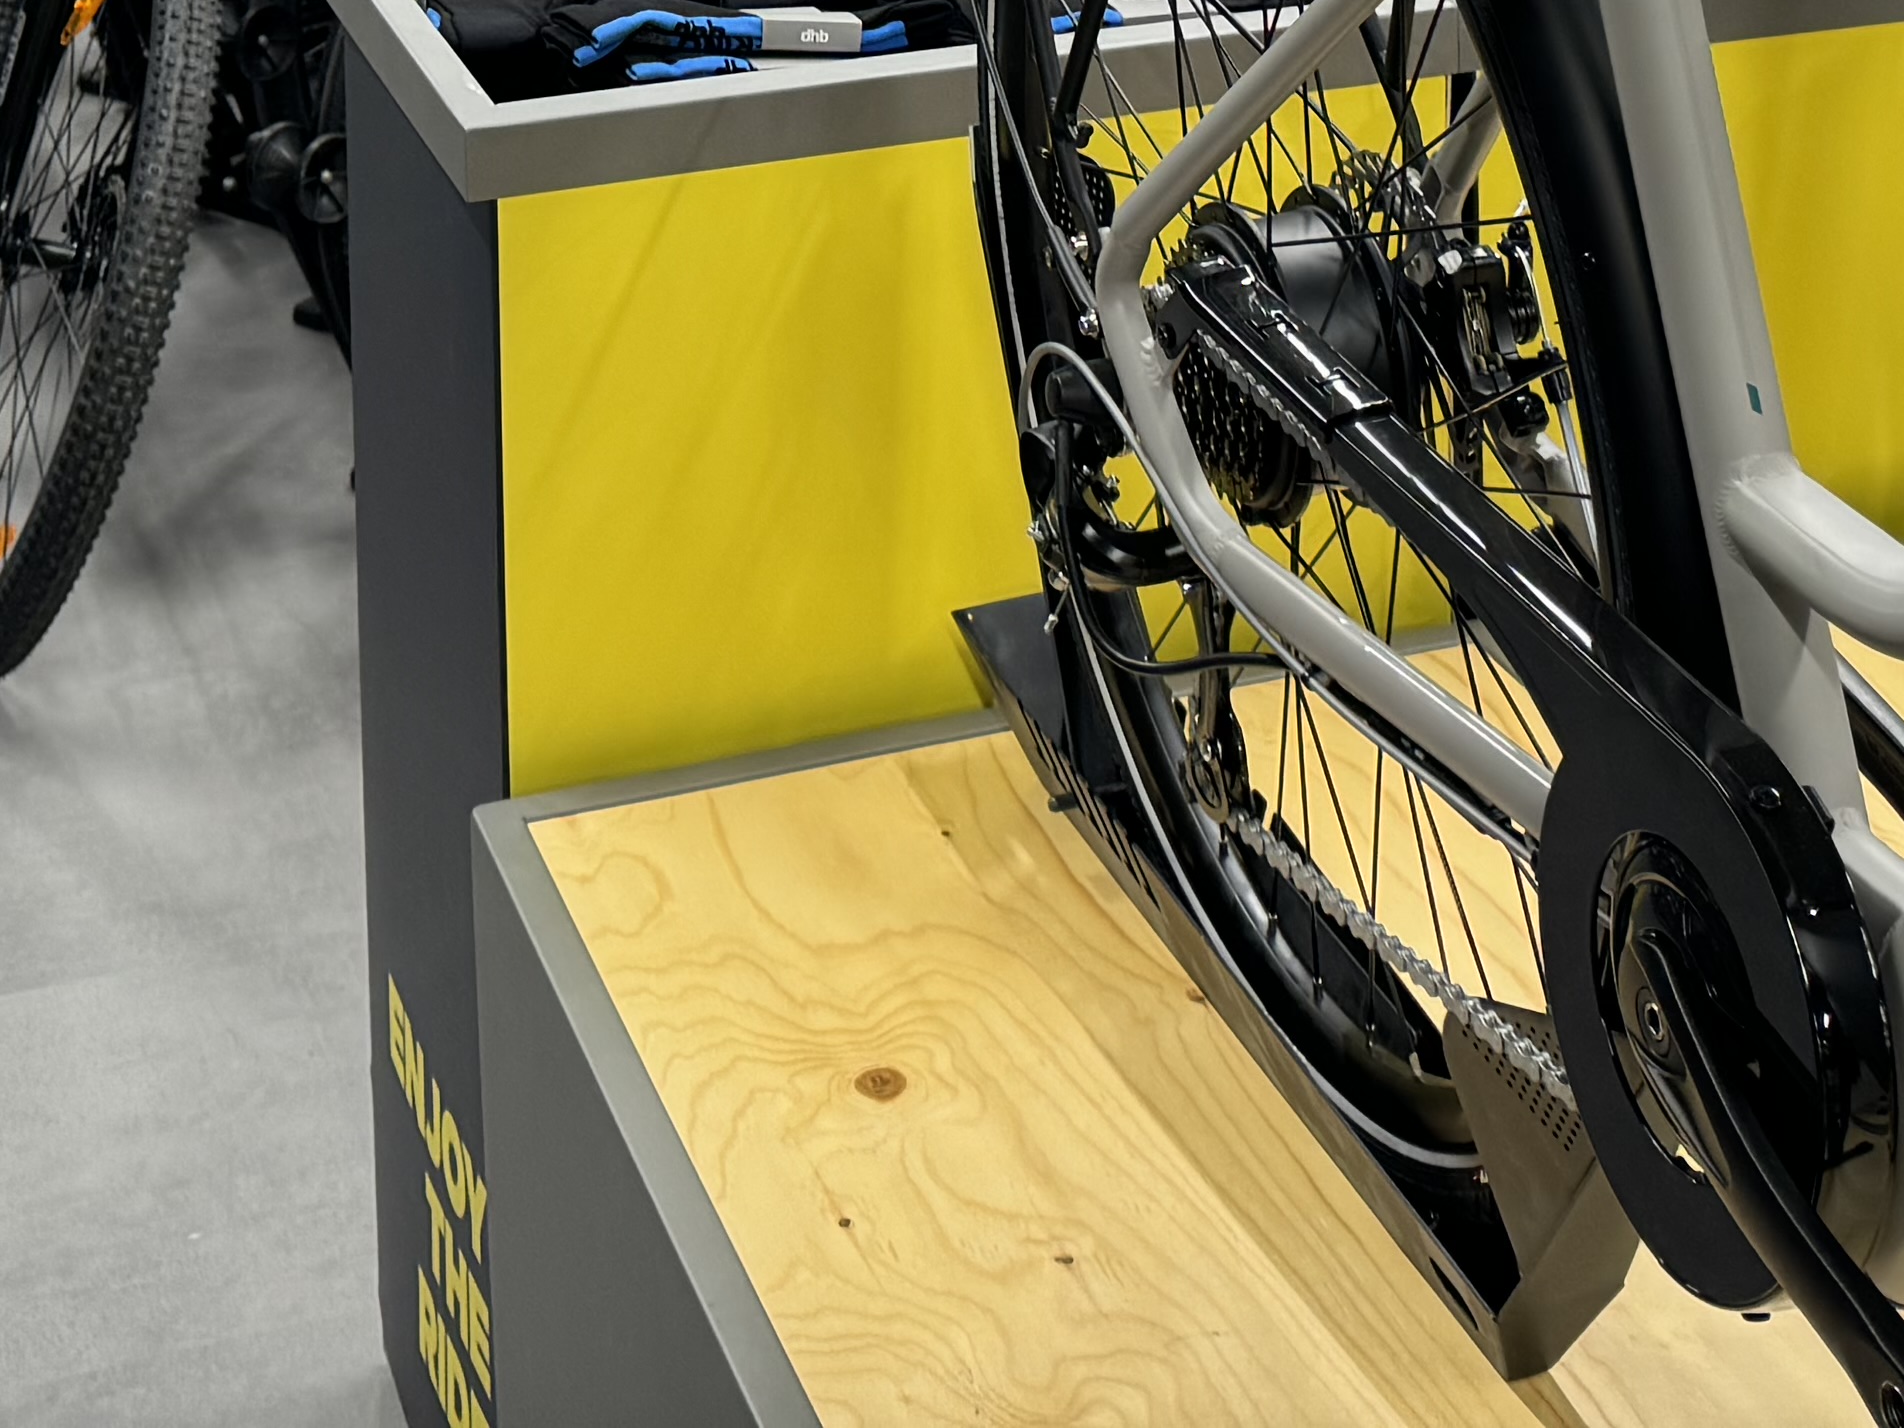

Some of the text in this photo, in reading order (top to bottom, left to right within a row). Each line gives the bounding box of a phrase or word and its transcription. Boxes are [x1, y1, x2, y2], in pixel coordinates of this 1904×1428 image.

[800, 28, 830, 44] dhb
[388, 973, 487, 1265] ENJOY
[425, 1171, 491, 1401] THE
